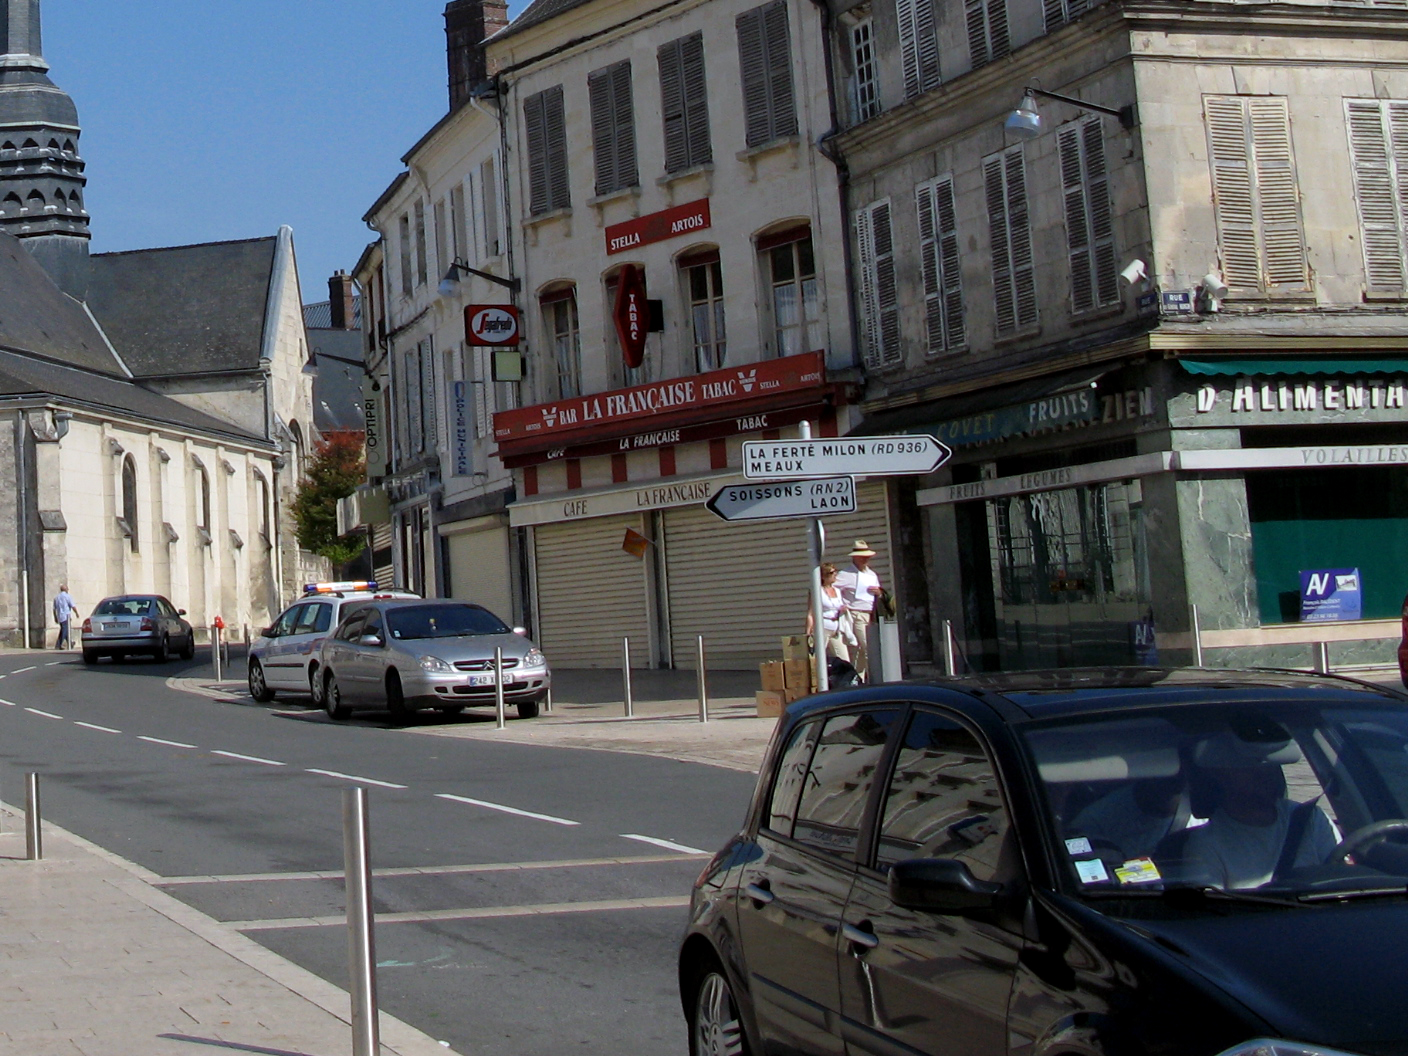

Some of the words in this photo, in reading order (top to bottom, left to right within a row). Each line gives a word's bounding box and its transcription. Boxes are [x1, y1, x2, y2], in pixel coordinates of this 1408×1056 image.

[610, 232, 641, 250] STELLA
[671, 213, 704, 234] ARTOIS
[1168, 294, 1184, 302] RUE
[628, 293, 639, 340] TABAC
[559, 408, 578, 425] BAR
[582, 398, 603, 421] LA
[606, 381, 696, 417] FRANÇAISE
[701, 379, 737, 400] TABAC
[760, 380, 780, 390] STELLA
[1029, 392, 1089, 423] FRUITS
[619, 437, 630, 450] LA
[736, 414, 769, 431] TABAC
[750, 447, 766, 460] LA
[773, 443, 816, 458] FERTÉ
[822, 445, 867, 457] MILON
[1301, 446, 1408, 464] VOLAILLES
[751, 460, 804, 473] MEAUX
[729, 485, 803, 502] SOISSONS
[950, 481, 986, 500] FRUITS
[1020, 468, 1072, 490] LEGUMES
[563, 500, 588, 517] CAFE
[637, 491, 651, 507] LA
[811, 496, 850, 510] LAON
